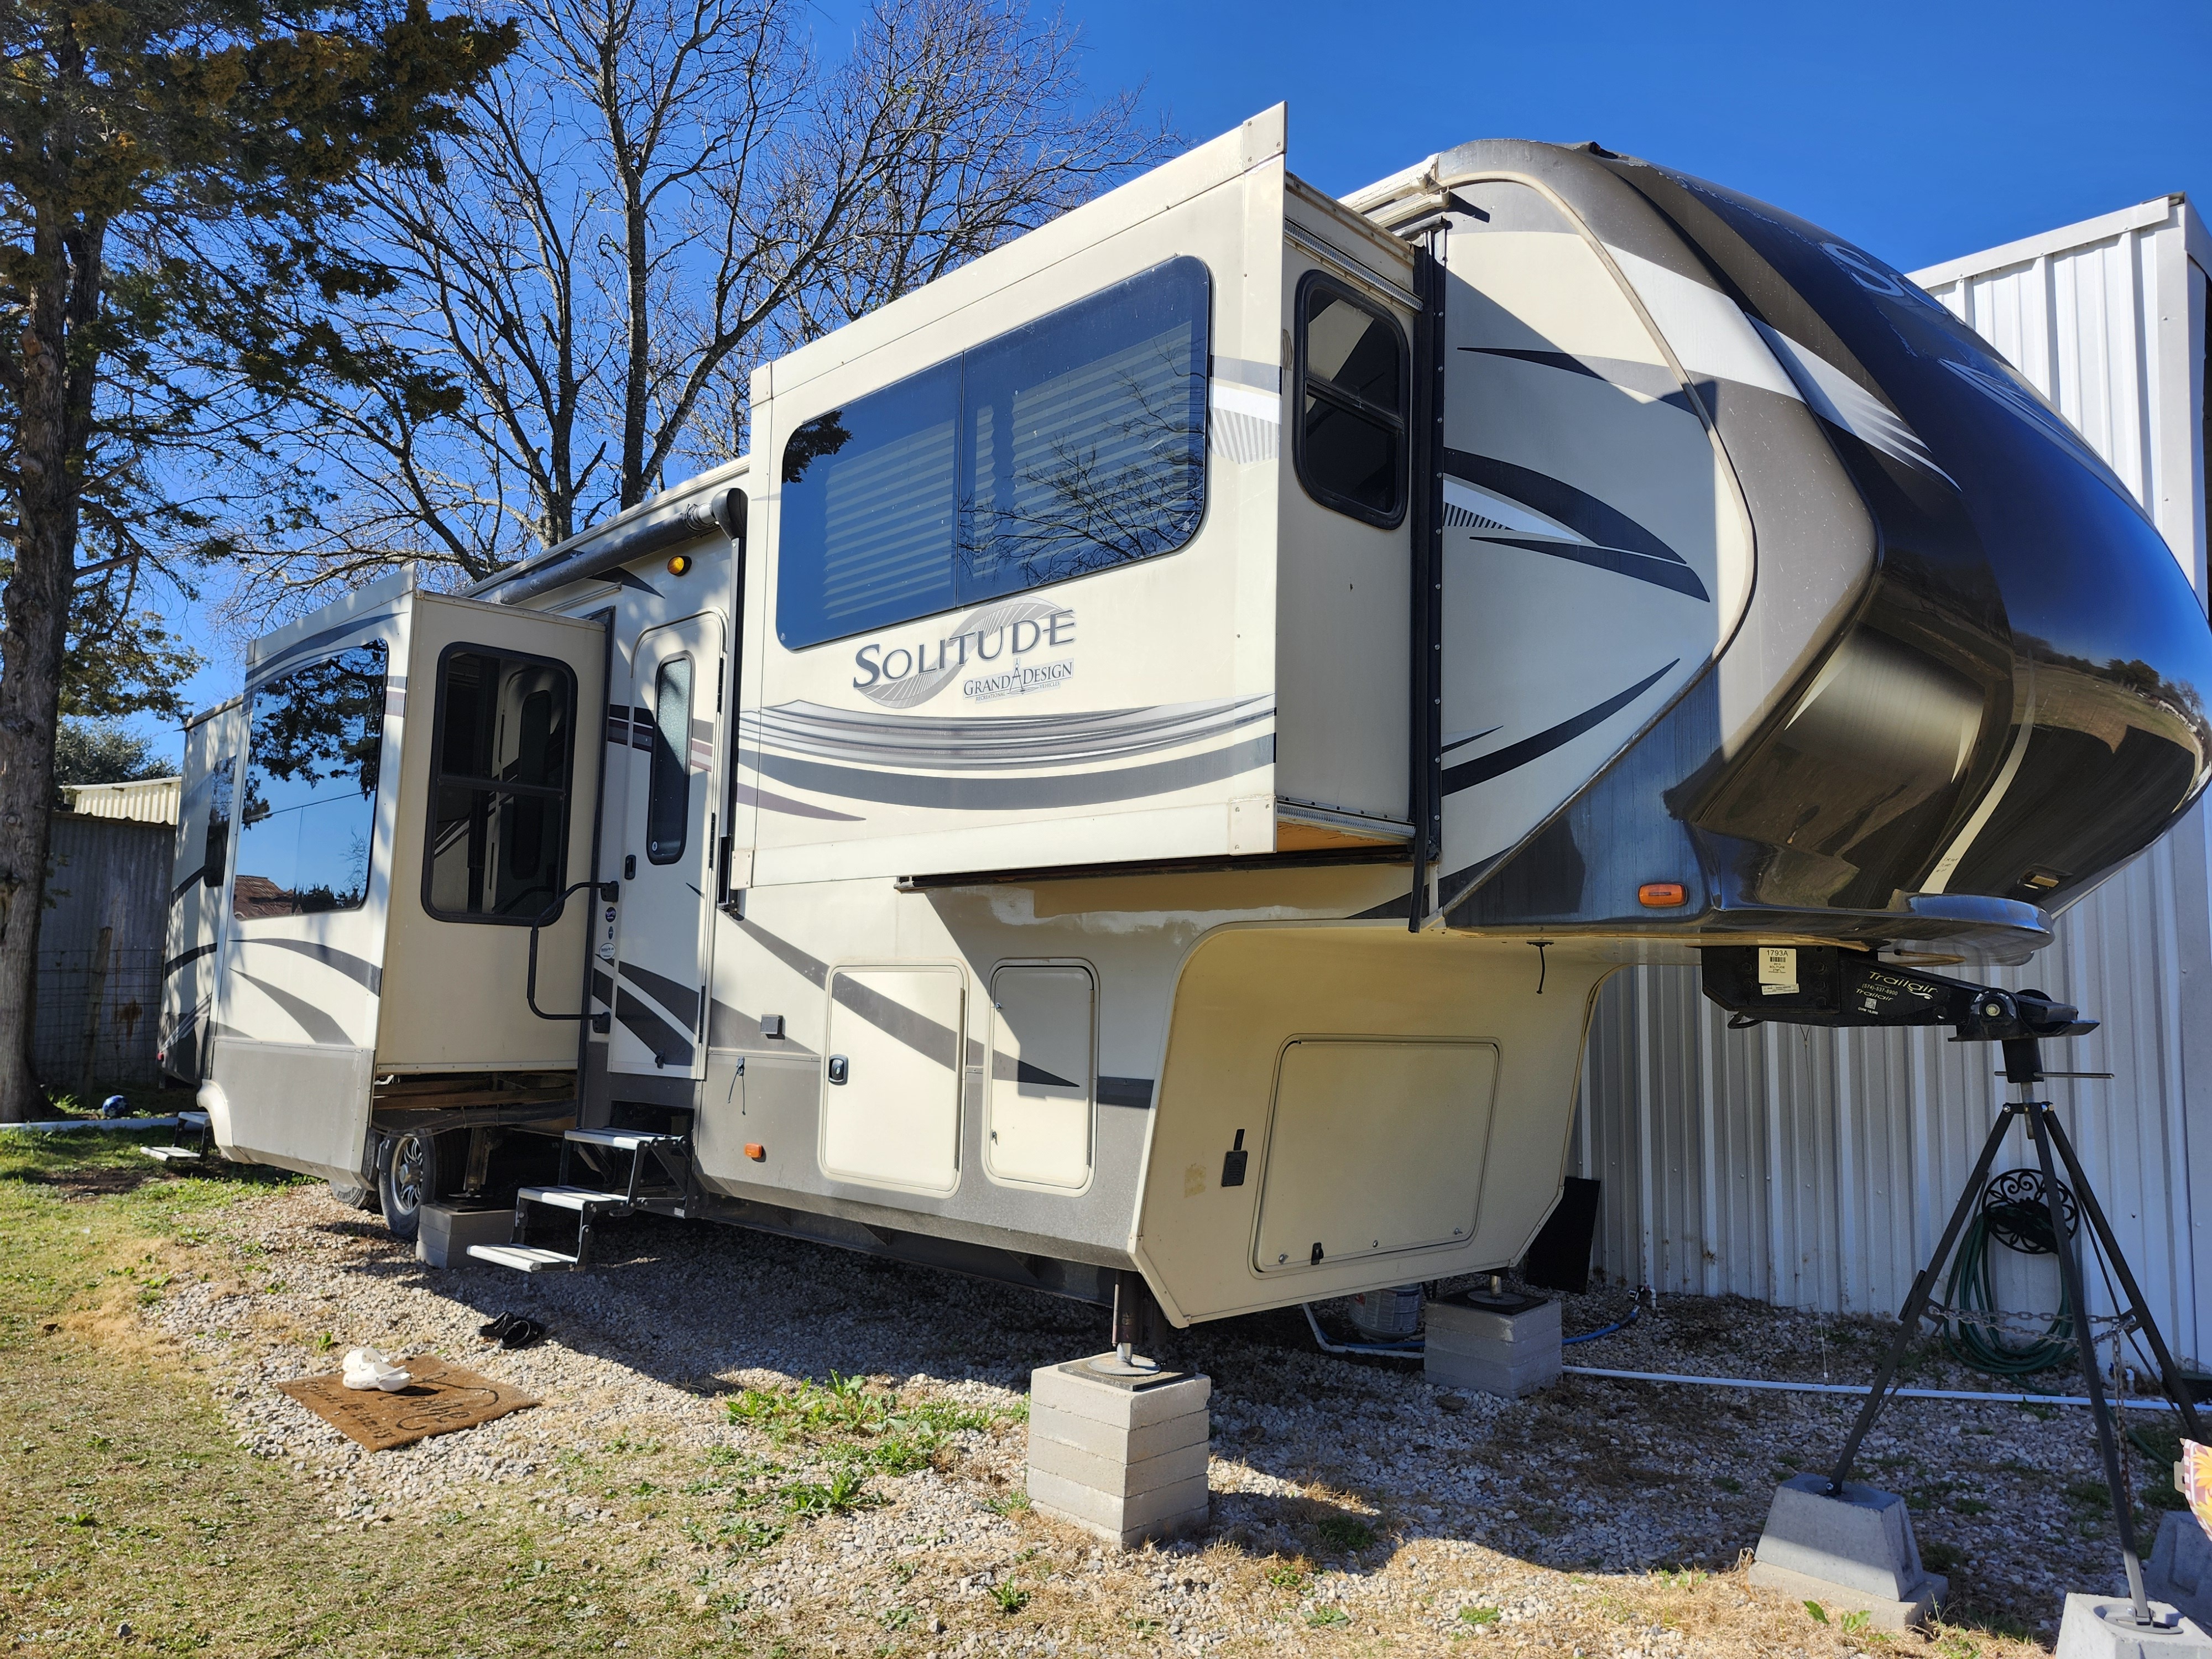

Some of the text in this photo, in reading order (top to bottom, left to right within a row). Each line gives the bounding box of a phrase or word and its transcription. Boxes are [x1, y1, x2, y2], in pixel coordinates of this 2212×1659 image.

[853, 609, 1076, 688] SOLITUDE
[964, 662, 1072, 696] GRAND DESIGN
[976, 692, 1005, 701] RECREATIONAL
[1869, 971, 1937, 994] Trailair
[1855, 988, 1894, 1001] Trailair
